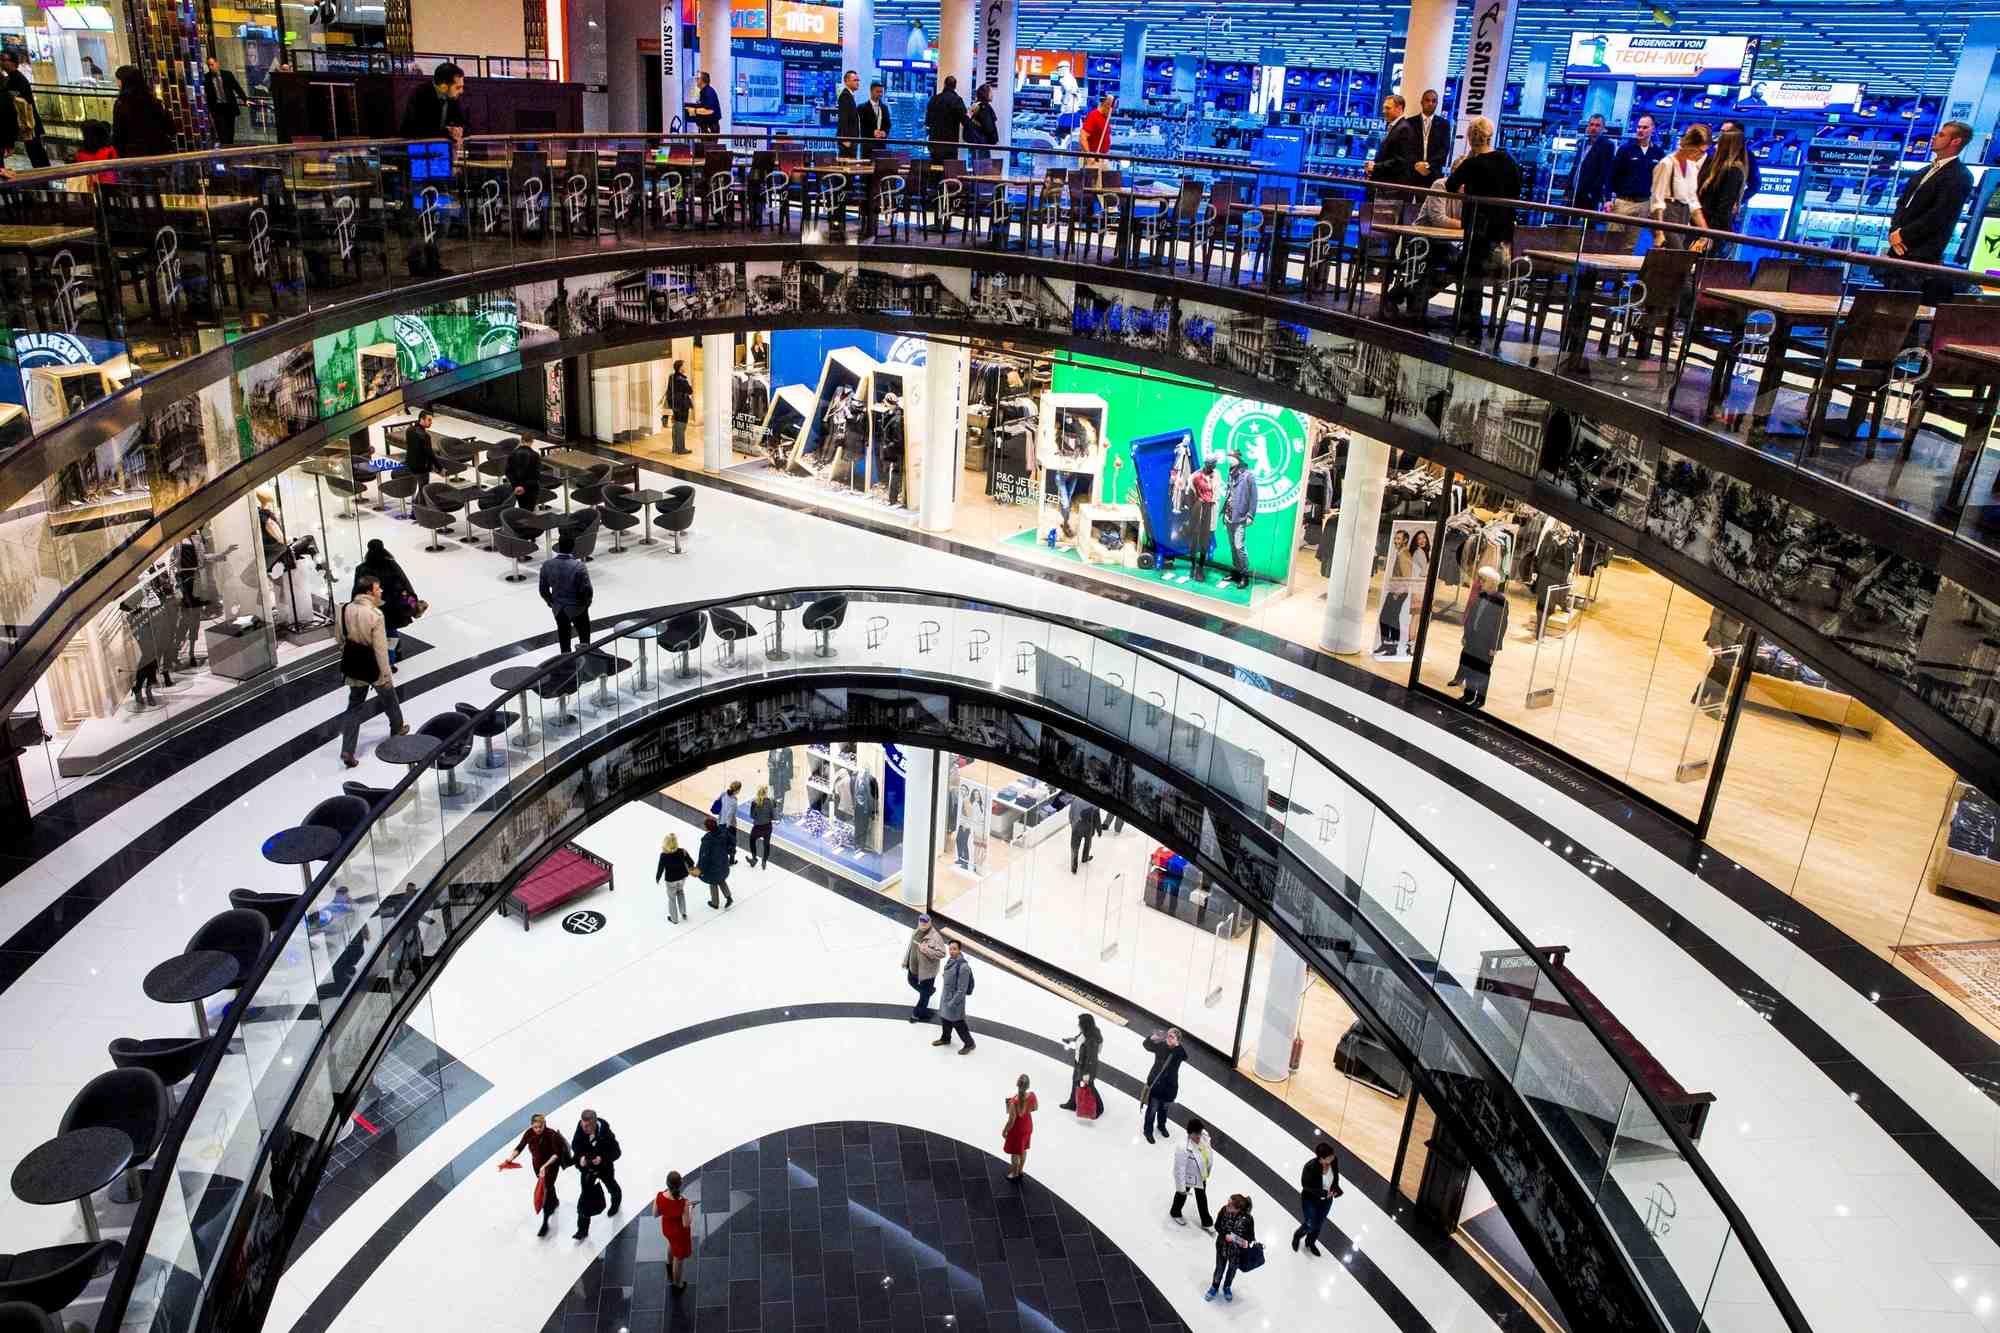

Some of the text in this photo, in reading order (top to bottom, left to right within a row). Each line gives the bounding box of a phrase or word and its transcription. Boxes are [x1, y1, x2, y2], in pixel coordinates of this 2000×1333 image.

[785, 12, 825, 33] INFO
[662, 25, 674, 76] SATURN
[1631, 38, 1706, 49] ABGENICKT VON
[1018, 56, 1043, 72] TE
[1616, 50, 1711, 66] TECH-NICK
[1466, 41, 1491, 116] SATURN
[996, 472, 1014, 483] P&C
[995, 482, 1014, 494] NEU
[1016, 486, 1027, 496] IM
